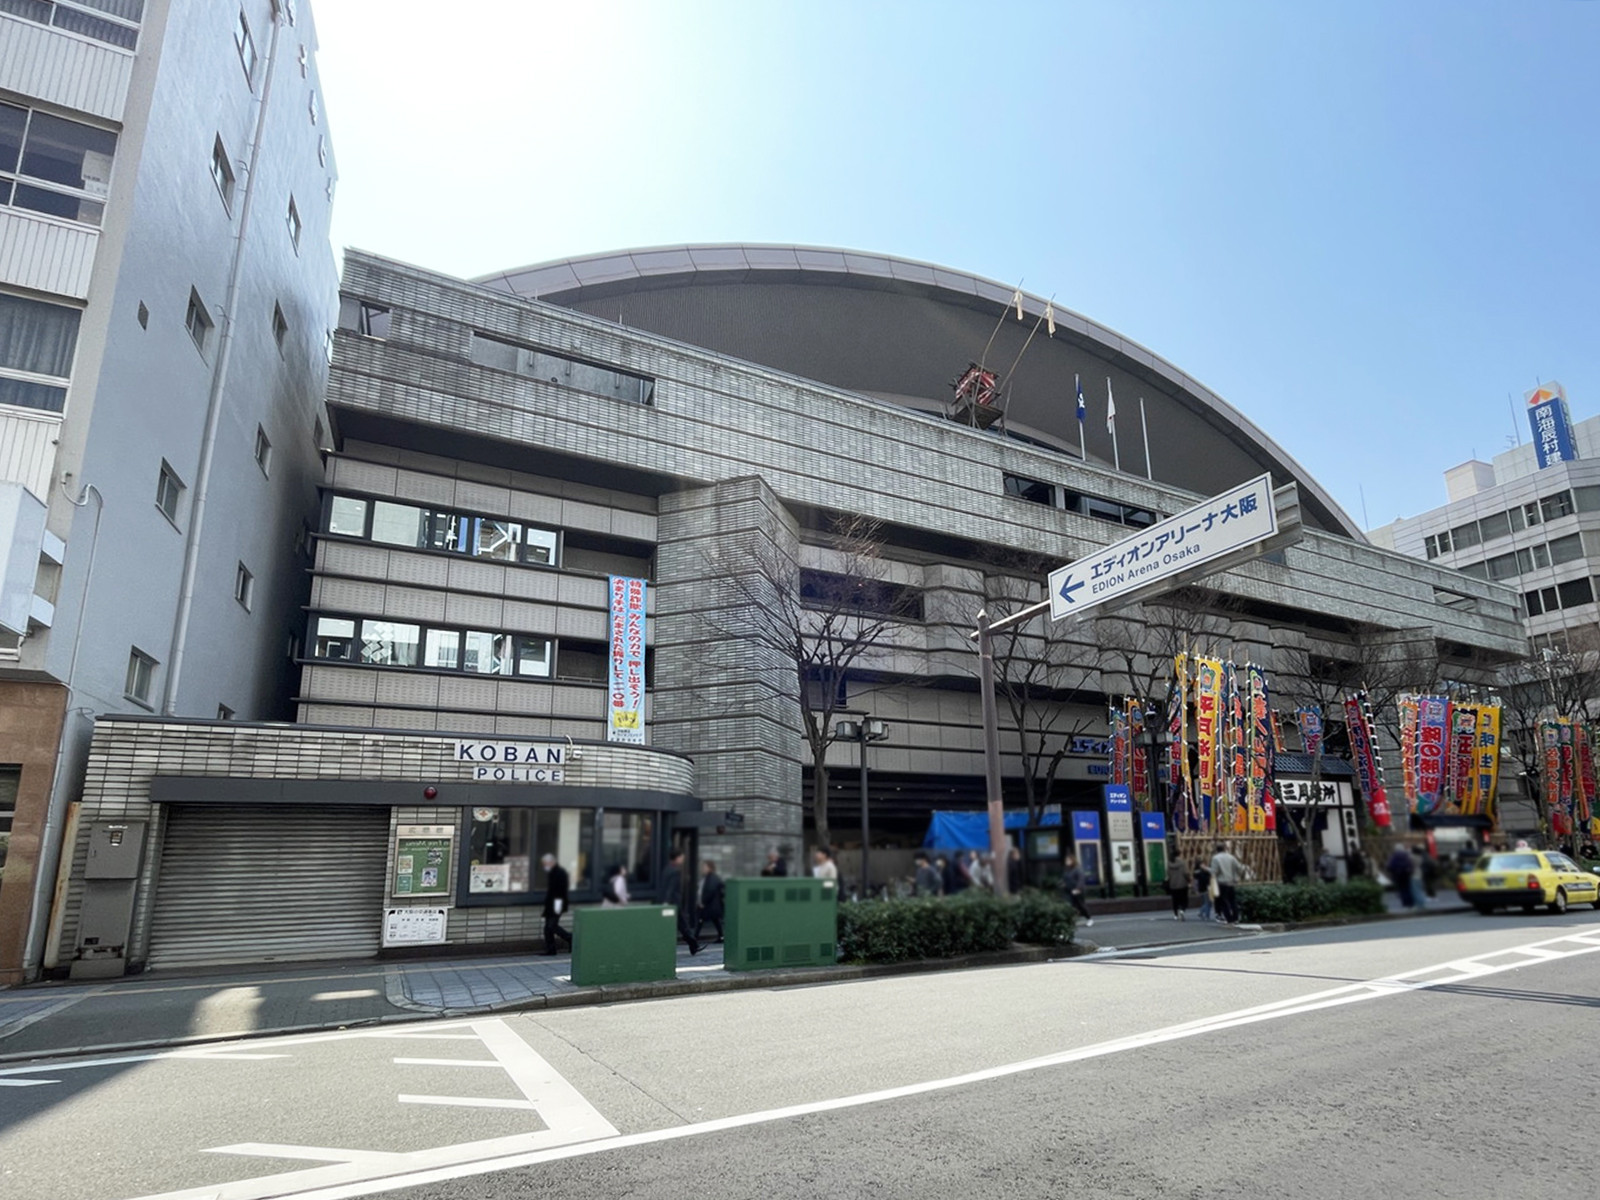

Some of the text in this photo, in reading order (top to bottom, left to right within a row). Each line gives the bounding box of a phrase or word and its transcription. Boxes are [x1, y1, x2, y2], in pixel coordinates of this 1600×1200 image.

[1090, 492, 1258, 581] エディオンアリーナ大阪
[1092, 542, 1201, 594] EDION Arena Osaka
[459, 743, 561, 764] KOBAN
[477, 767, 561, 782] POLICE
